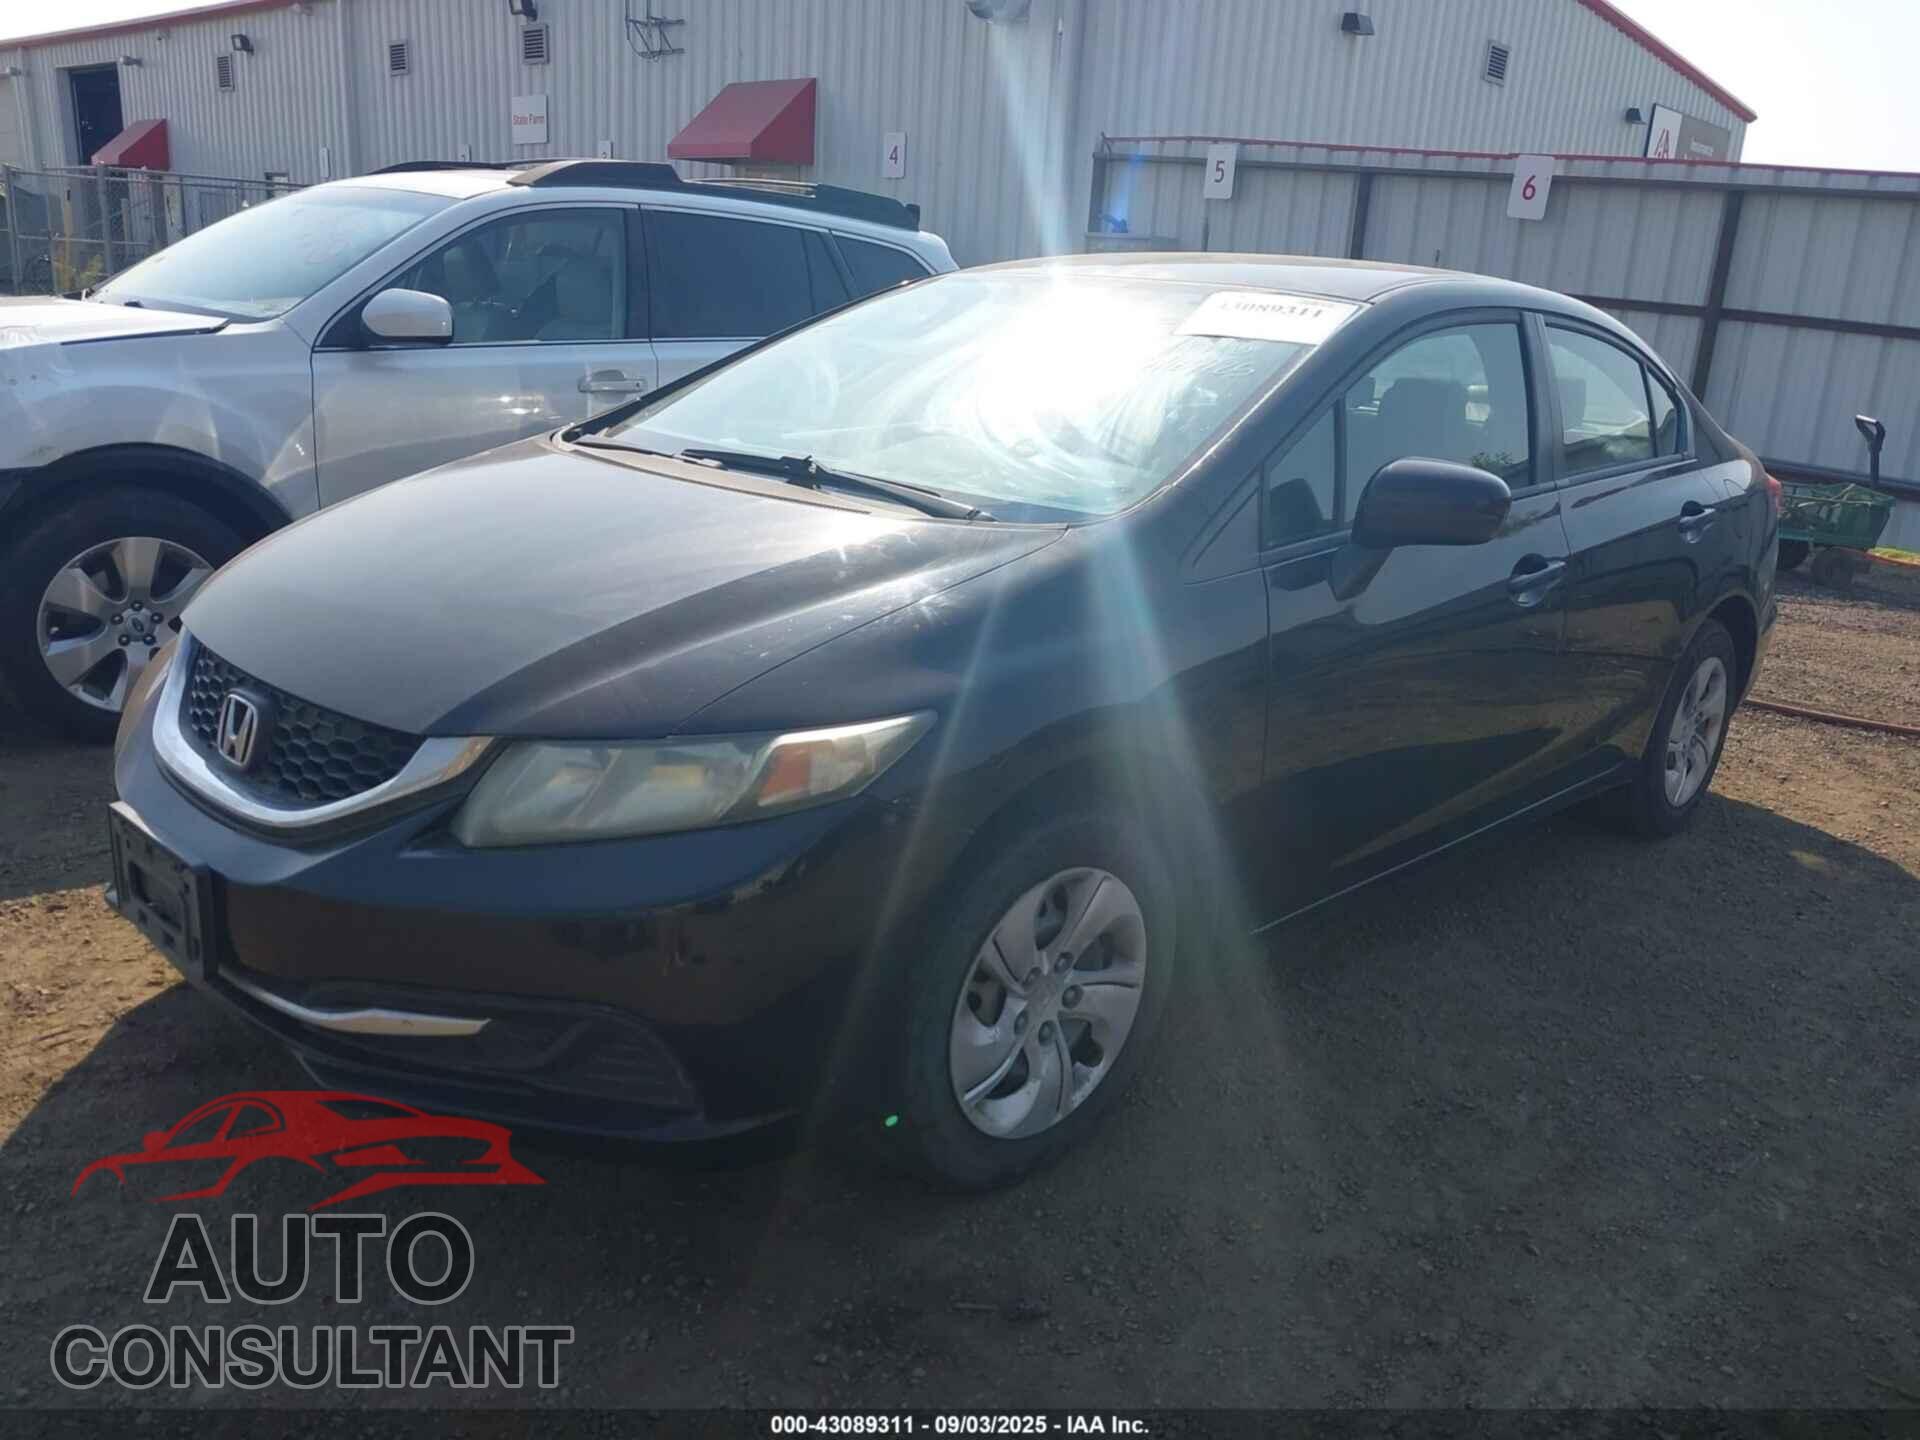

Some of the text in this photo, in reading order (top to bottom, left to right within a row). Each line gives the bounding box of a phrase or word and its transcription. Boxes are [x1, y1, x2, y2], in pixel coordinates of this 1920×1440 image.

[889, 144, 898, 165] 4
[1214, 159, 1225, 183] 5
[1522, 174, 1536, 200] 6
